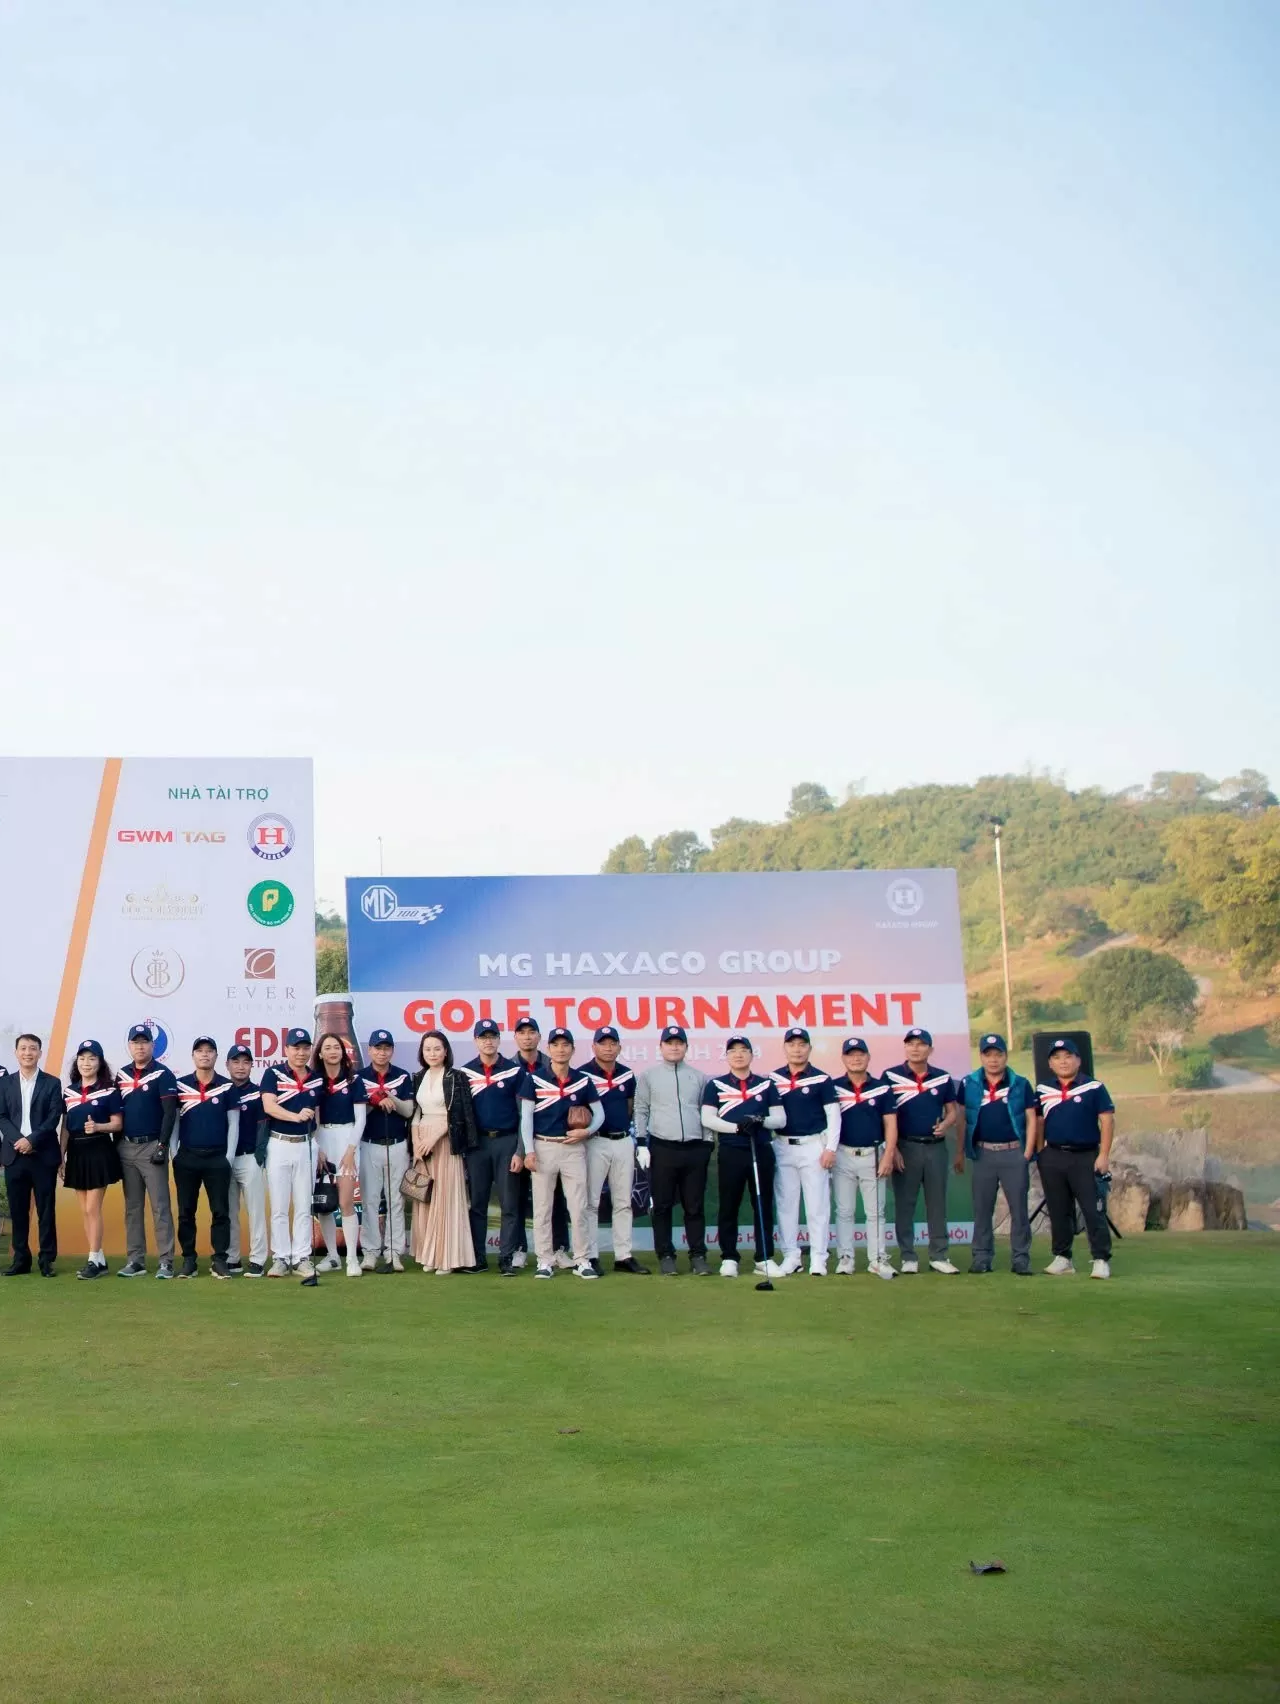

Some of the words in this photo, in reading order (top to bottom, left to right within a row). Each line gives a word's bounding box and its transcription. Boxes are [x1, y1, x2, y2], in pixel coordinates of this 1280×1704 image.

[168, 784, 201, 800] NHÀ
[206, 784, 231, 800] TÀI
[235, 786, 269, 803] TRỢ
[117, 830, 173, 843] GWM
[181, 831, 227, 843] TAG
[364, 888, 396, 919] MG
[478, 952, 533, 978] MG
[545, 950, 706, 977] HAXACO
[718, 949, 842, 975] GROUP
[226, 986, 297, 999] EVER
[403, 998, 531, 1034] GOLF
[544, 993, 922, 1032] TOURNAMENT
